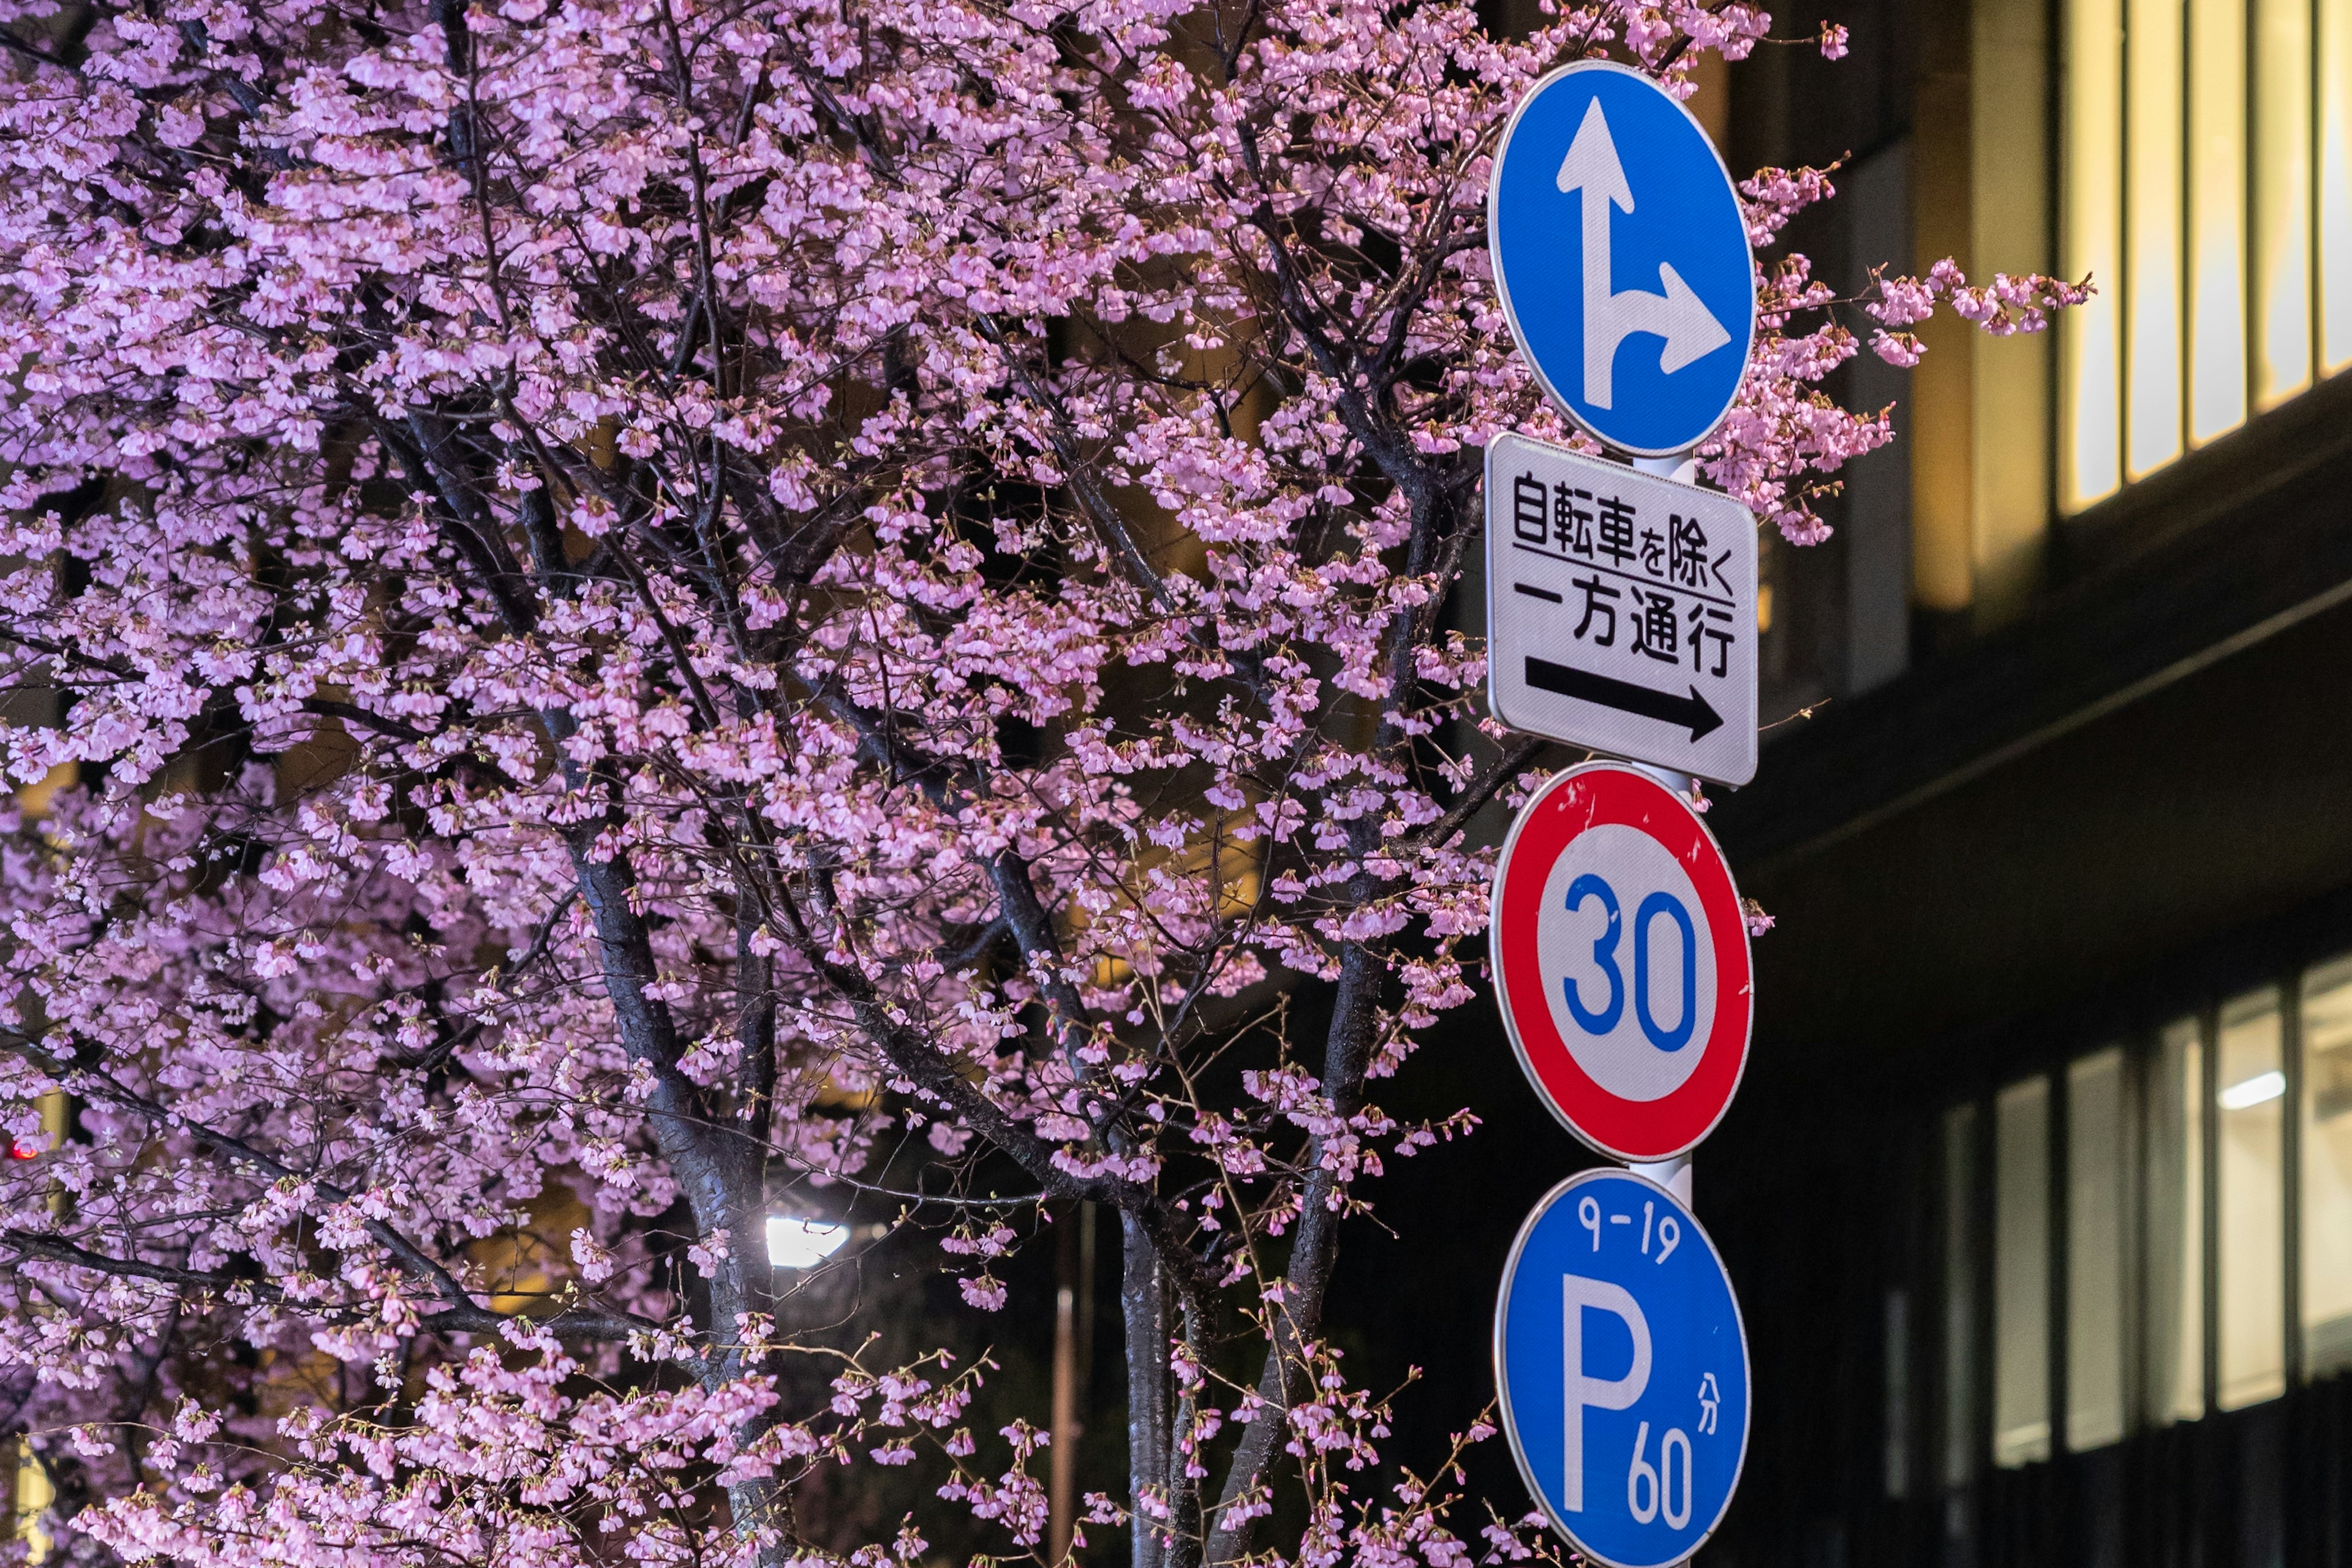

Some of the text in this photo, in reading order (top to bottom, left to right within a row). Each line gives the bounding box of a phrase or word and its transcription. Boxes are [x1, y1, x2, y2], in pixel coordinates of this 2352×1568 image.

[1513, 470, 1733, 597] 自転車を除く
[1514, 574, 1735, 678] 一方通行
[1563, 873, 1695, 1052] 30
[1578, 1196, 1681, 1265] 9-19
[1563, 1273, 1653, 1513] P
[1627, 1372, 1721, 1531] 60 分
